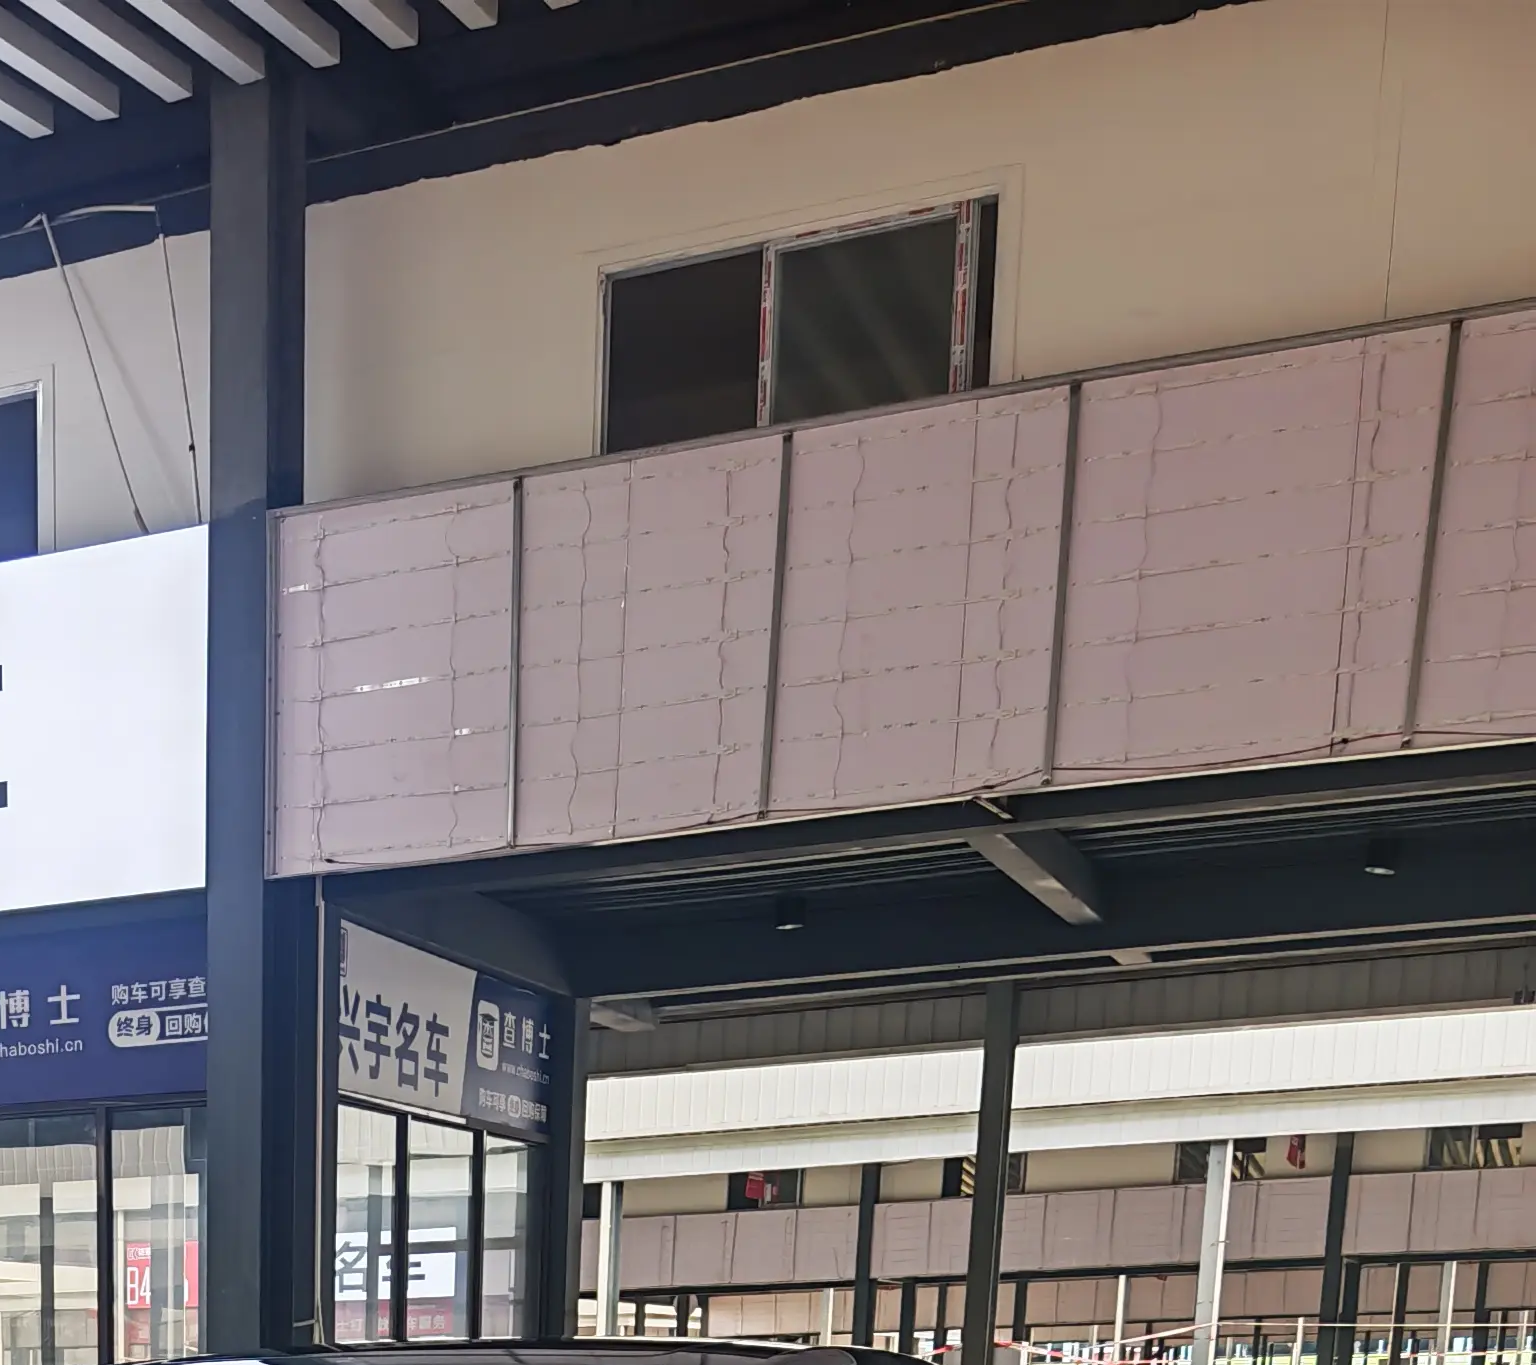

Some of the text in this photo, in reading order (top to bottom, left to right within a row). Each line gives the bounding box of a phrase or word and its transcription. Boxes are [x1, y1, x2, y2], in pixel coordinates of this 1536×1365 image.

[116, 1008, 208, 1037] 终身 回购
[339, 984, 449, 1097] 兴宇名车
[503, 1011, 551, 1060] 查博士
